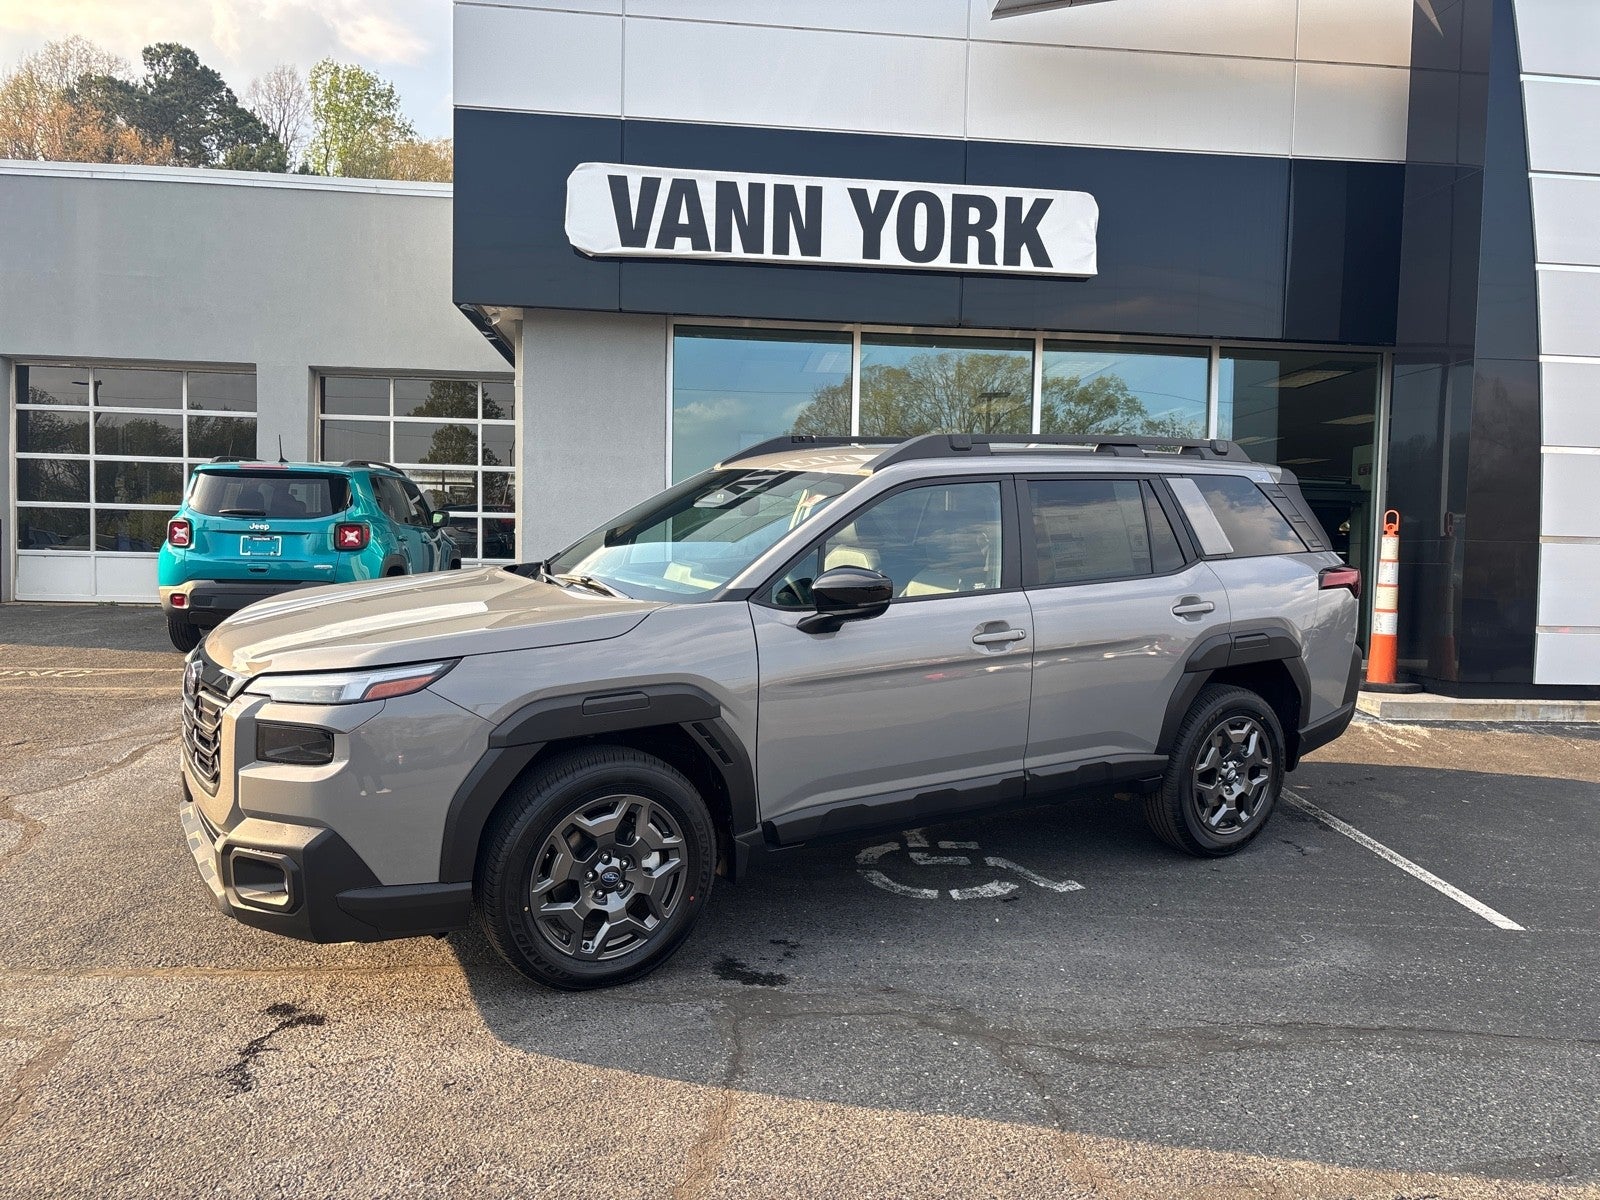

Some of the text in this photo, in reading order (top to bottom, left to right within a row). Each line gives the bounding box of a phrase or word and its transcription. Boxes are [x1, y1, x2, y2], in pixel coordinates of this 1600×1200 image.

[607, 174, 1054, 268] VANN YORK
[249, 522, 270, 531] Jeep
